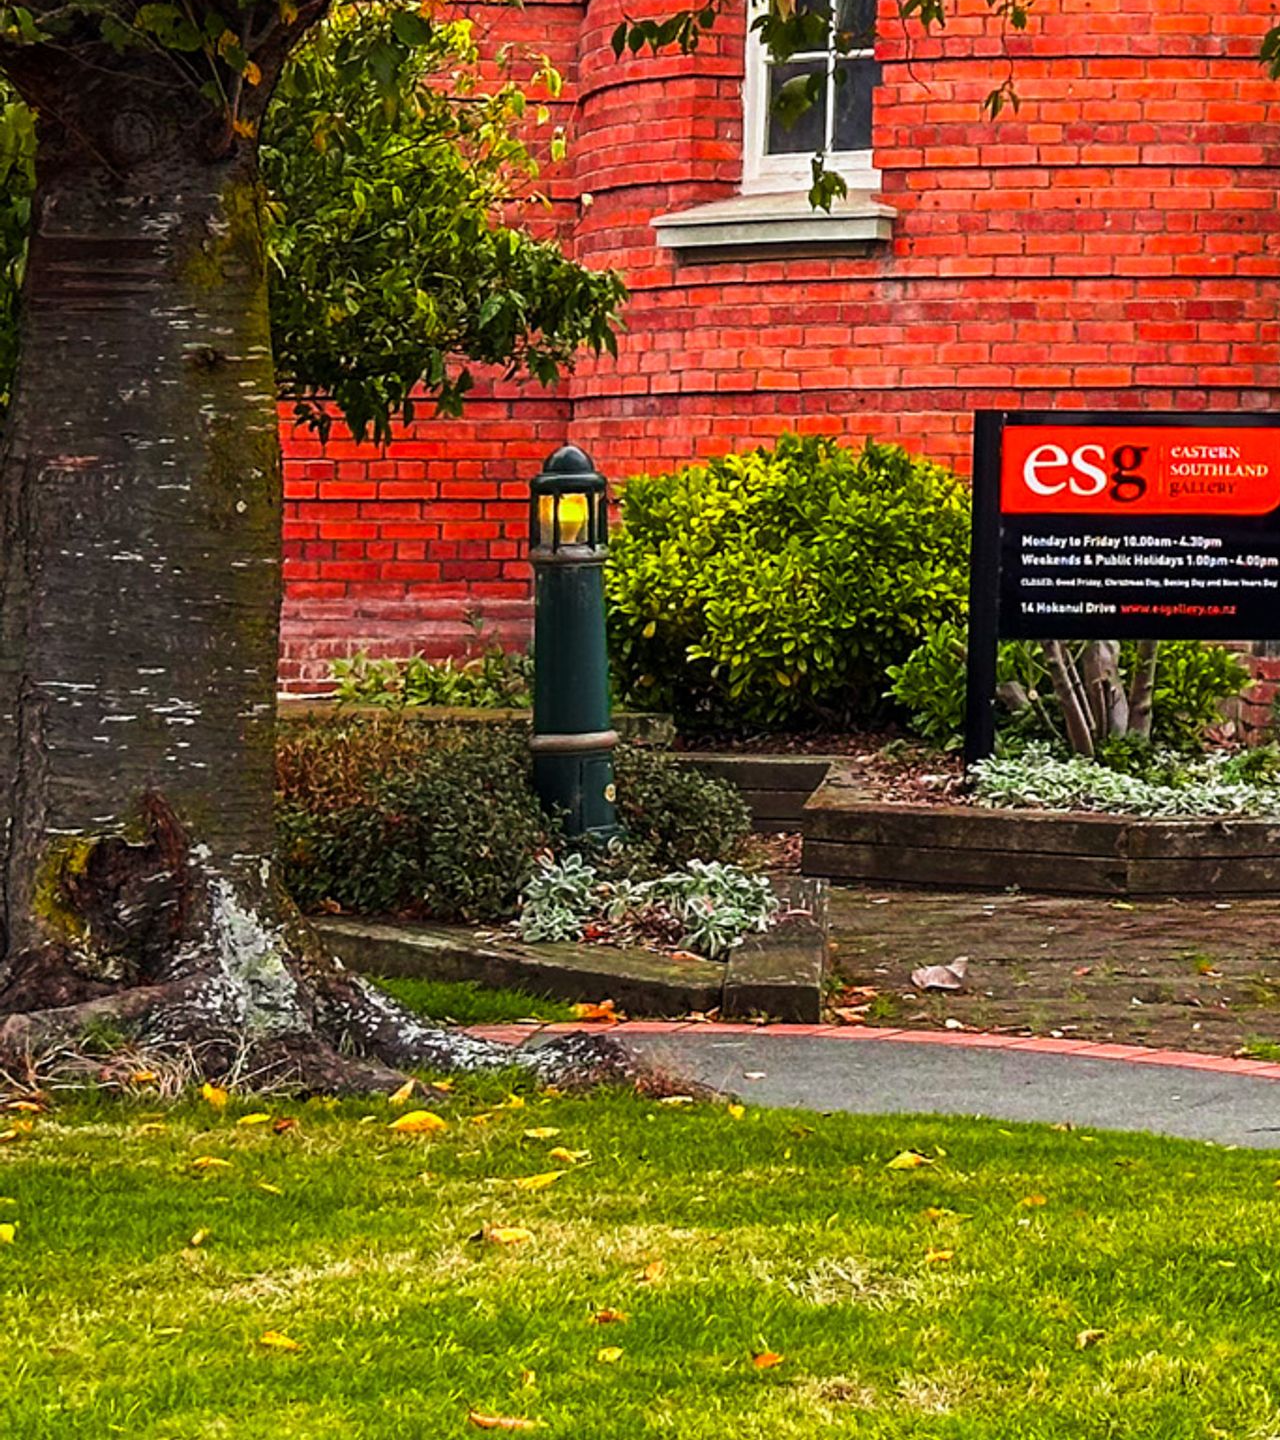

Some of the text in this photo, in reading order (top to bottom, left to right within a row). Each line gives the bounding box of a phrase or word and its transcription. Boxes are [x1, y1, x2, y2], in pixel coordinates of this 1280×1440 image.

[1023, 444, 1149, 502] esg
[1170, 464, 1269, 477] SOUTHLAND
[1022, 535, 1068, 549] Monday
[1069, 536, 1081, 547] to
[1083, 535, 1120, 549] Friday
[1021, 553, 1081, 565] Weekends
[1083, 554, 1093, 565] &
[1095, 554, 1132, 565] Public
[1134, 554, 1184, 568] Holidays
[1021, 602, 1034, 613] 14
[1037, 602, 1083, 613] Hokonui
[1086, 602, 1117, 613] Drive
